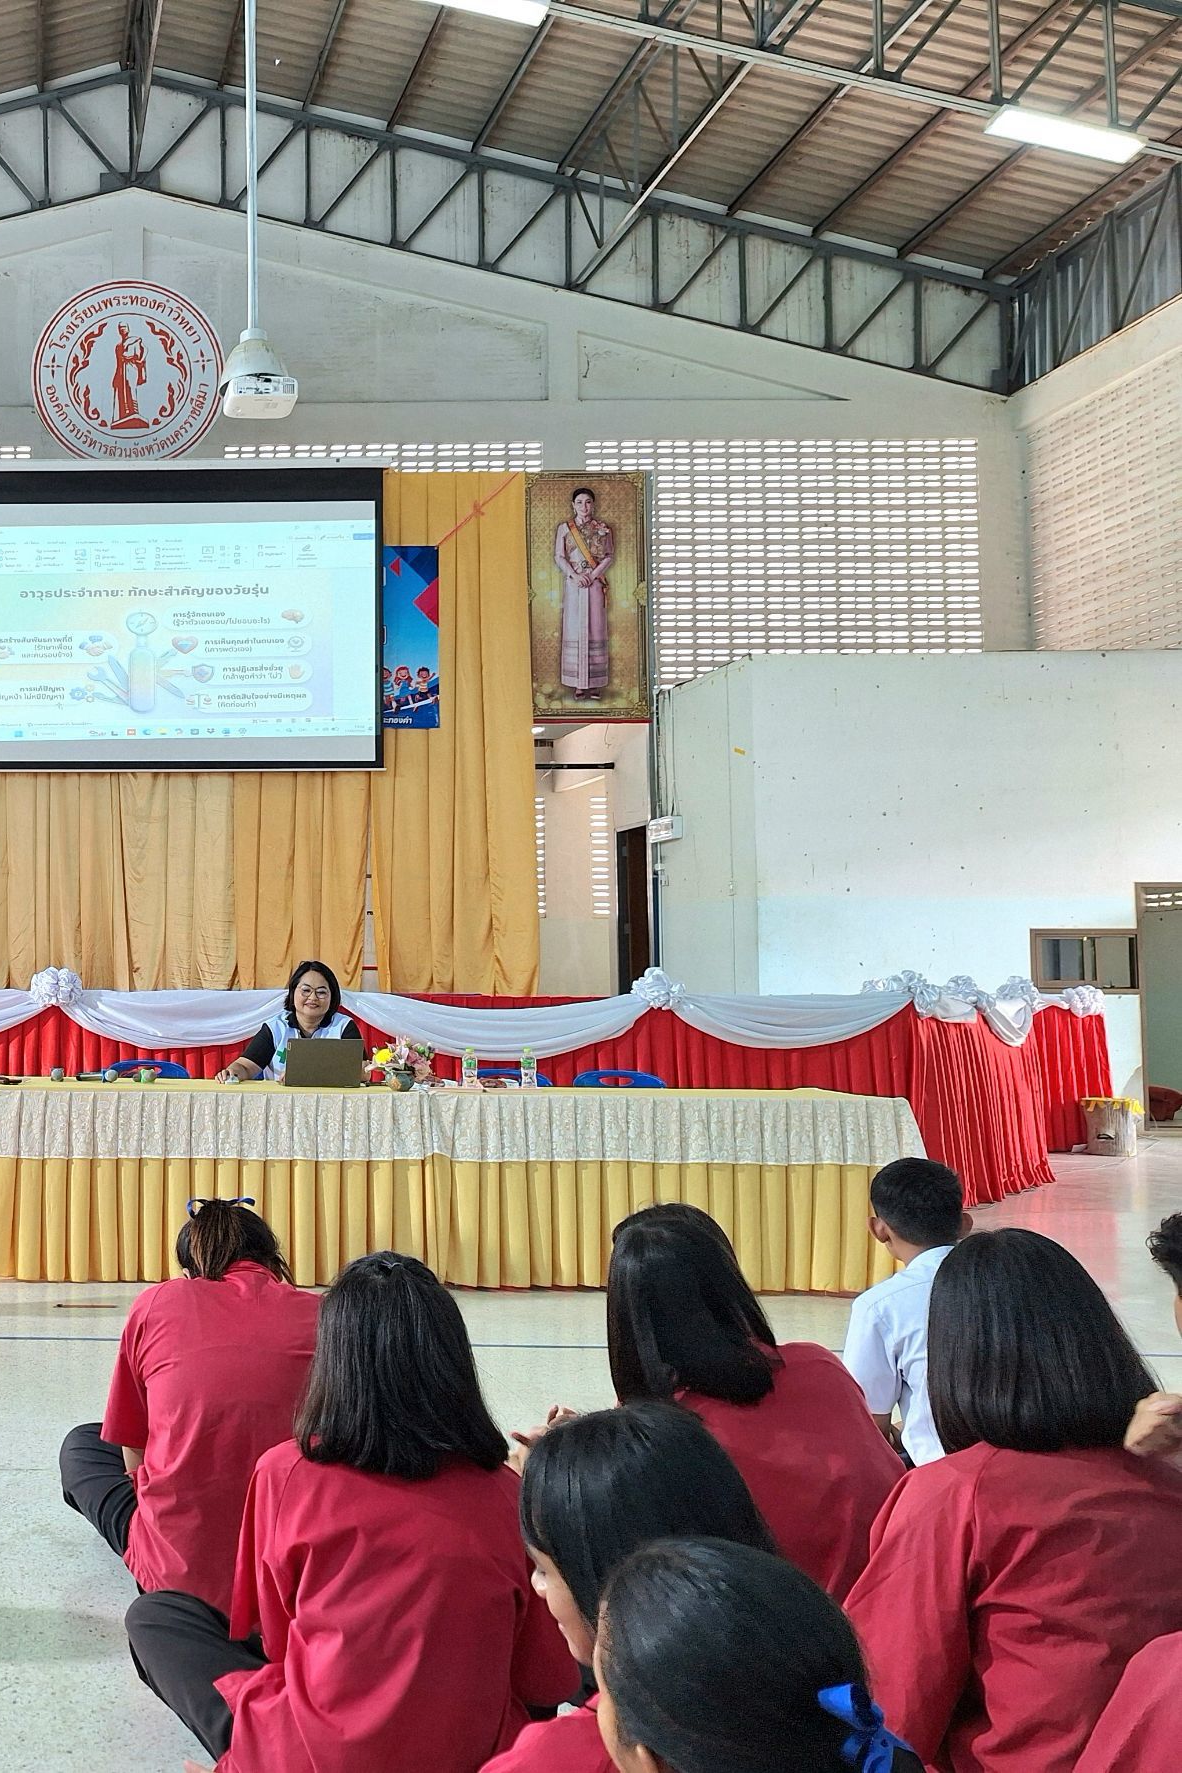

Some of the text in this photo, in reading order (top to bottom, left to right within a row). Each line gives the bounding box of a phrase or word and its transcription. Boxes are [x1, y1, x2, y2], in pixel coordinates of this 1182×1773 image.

[49, 295, 201, 349] โรงเรียนพระทองคำวิทยา
[46, 382, 209, 458] องค์การบริหารส่วนจังหวัดนครราชสีมา
[20, 584, 269, 601] อาวุธประจำกาย: ทักษะสำคัญของวัยรุ่น
